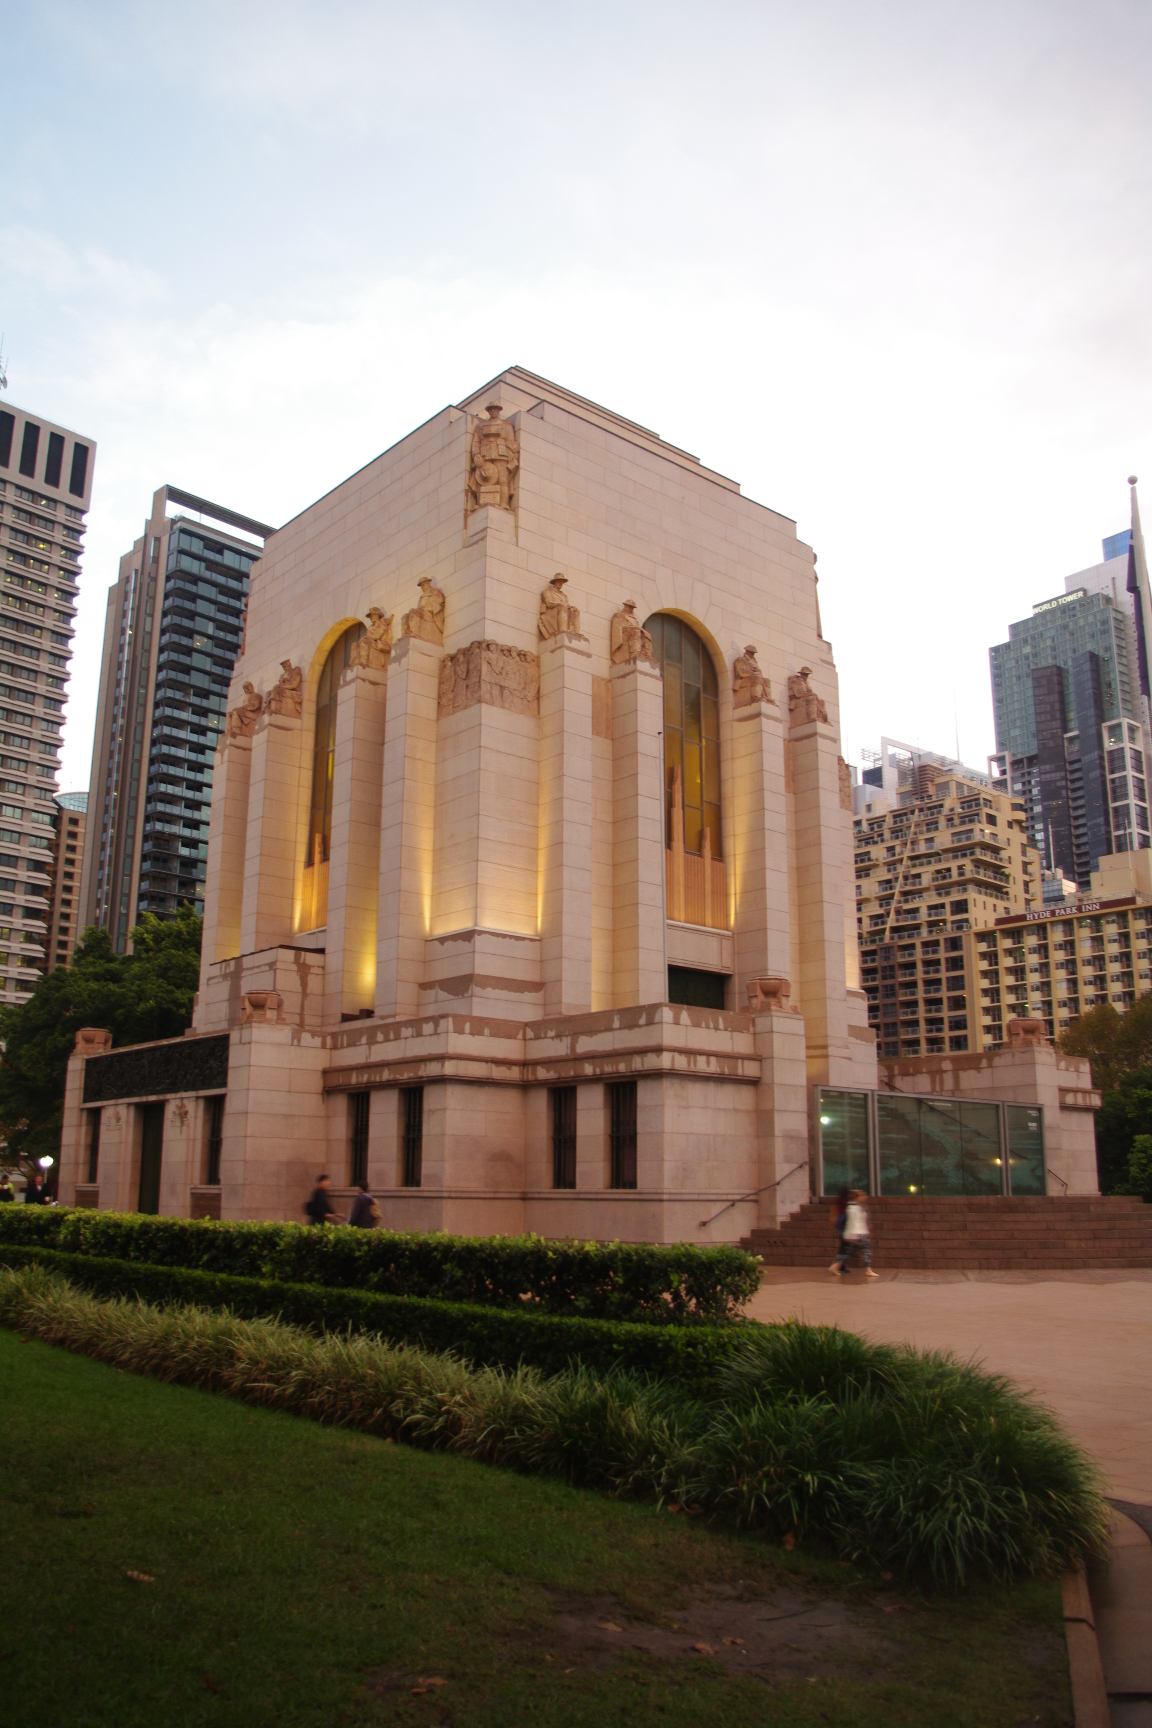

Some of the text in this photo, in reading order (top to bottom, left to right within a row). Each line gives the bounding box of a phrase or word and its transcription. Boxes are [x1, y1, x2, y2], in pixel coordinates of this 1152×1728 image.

[1033, 591, 1083, 614] WORLD TOWER
[1026, 903, 1100, 920] HYDE PARK INN
